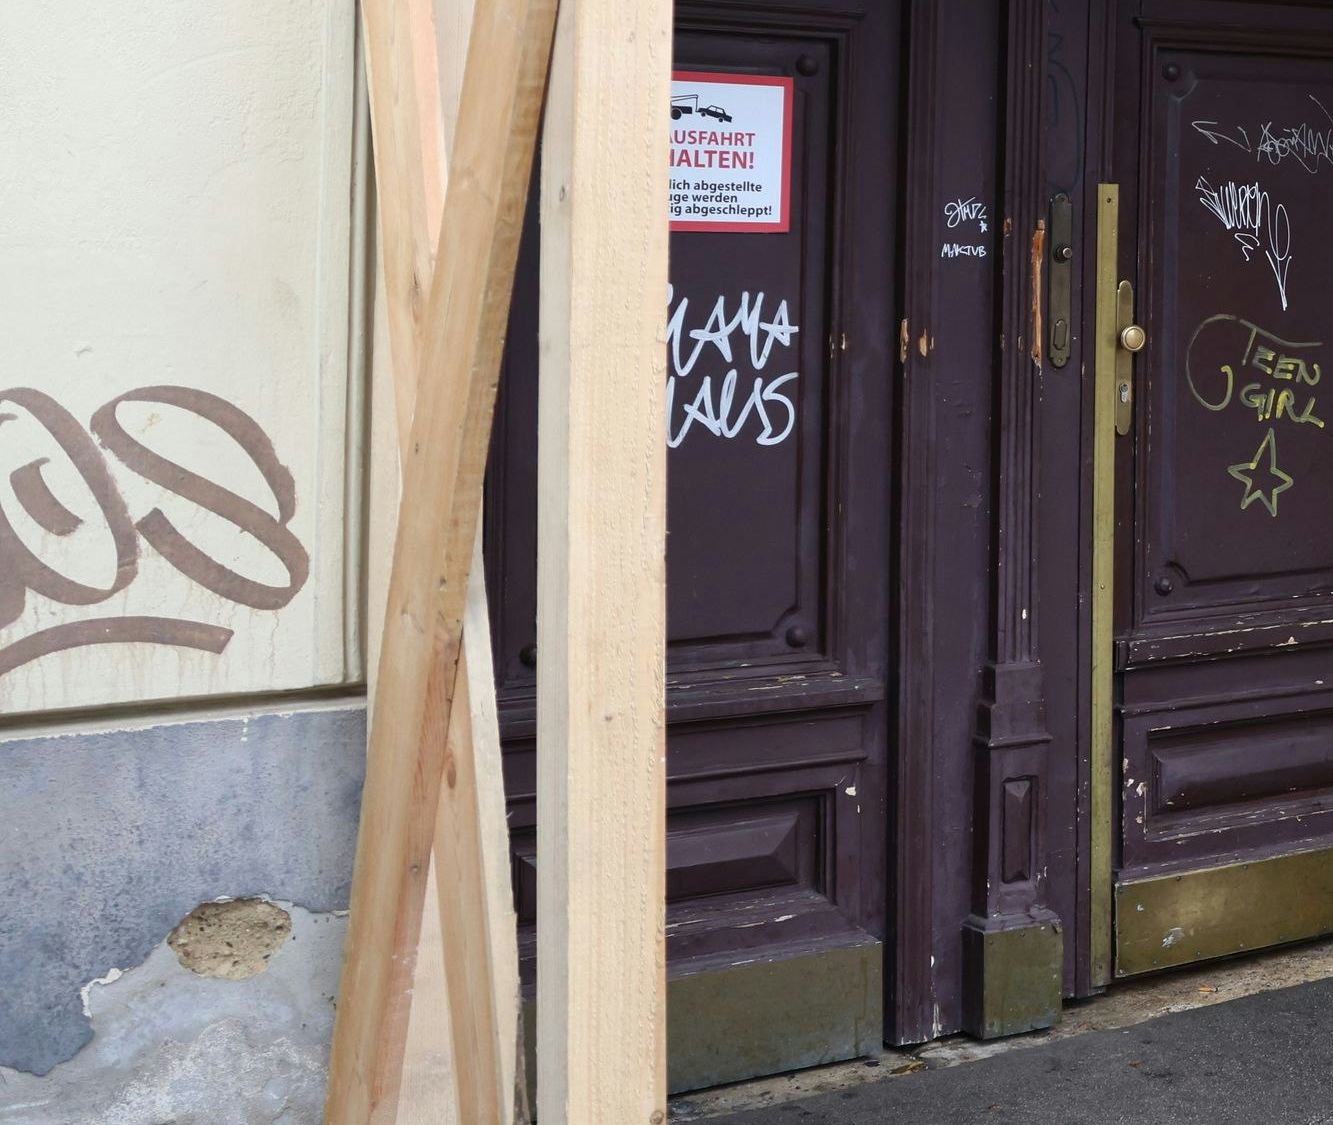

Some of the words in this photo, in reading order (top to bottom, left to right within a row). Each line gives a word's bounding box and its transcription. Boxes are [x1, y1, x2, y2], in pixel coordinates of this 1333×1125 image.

[693, 180, 762, 194] abgestellte
[692, 193, 738, 204] werden
[685, 203, 772, 218] abgeschleppt!
